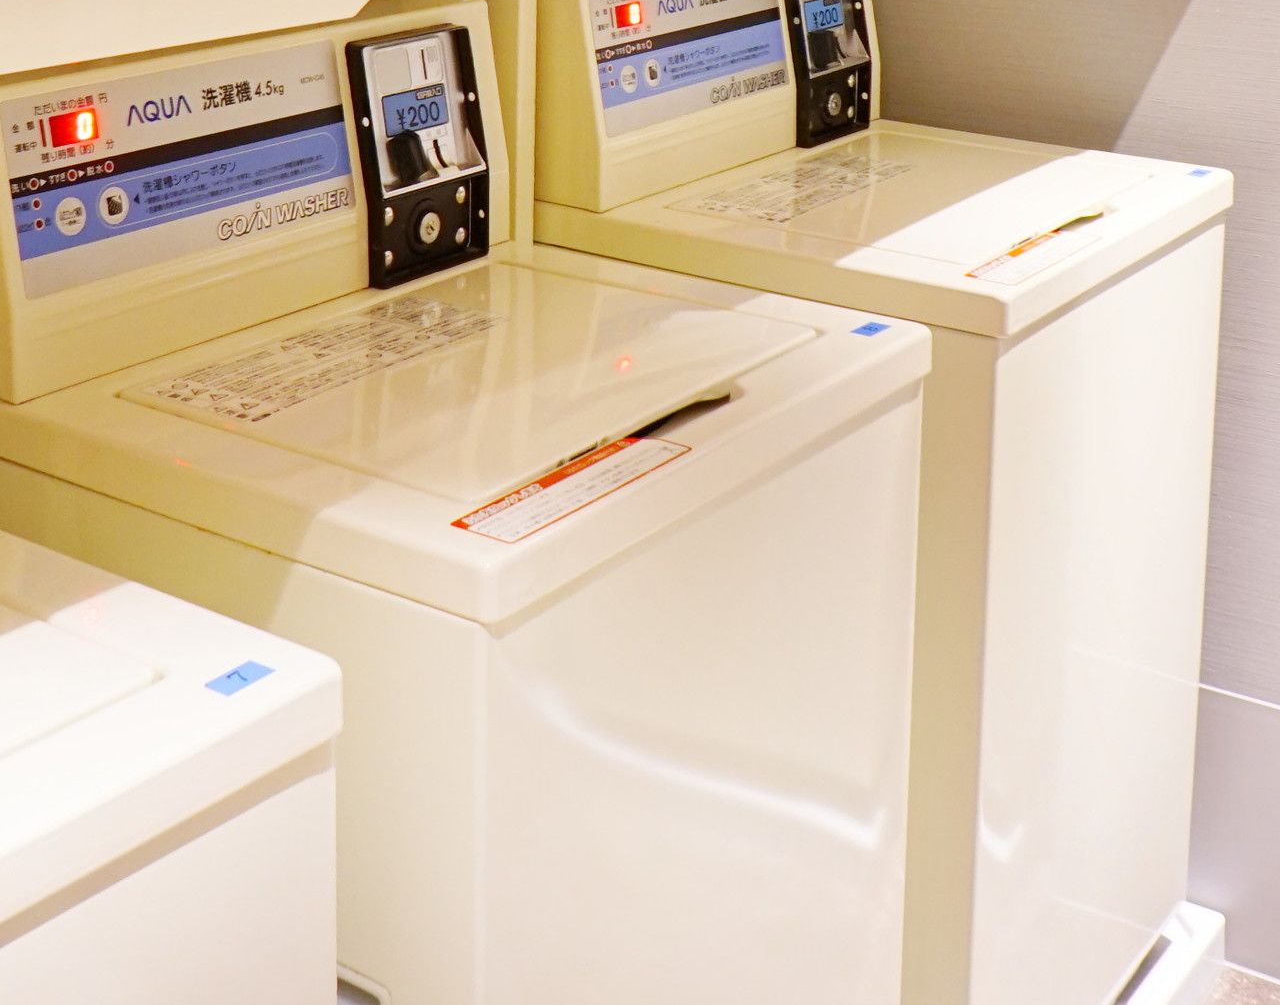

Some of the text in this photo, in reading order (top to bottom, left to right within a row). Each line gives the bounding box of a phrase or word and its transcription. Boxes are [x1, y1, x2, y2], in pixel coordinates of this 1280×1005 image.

[811, 7, 839, 29] ¥200
[201, 79, 285, 111] 洗濯機 4.5kg
[743, 68, 787, 96] WASHER
[75, 111, 94, 141] 0
[126, 94, 192, 127] AQUA
[395, 100, 441, 131] ¥200
[273, 186, 351, 224] WASHER
